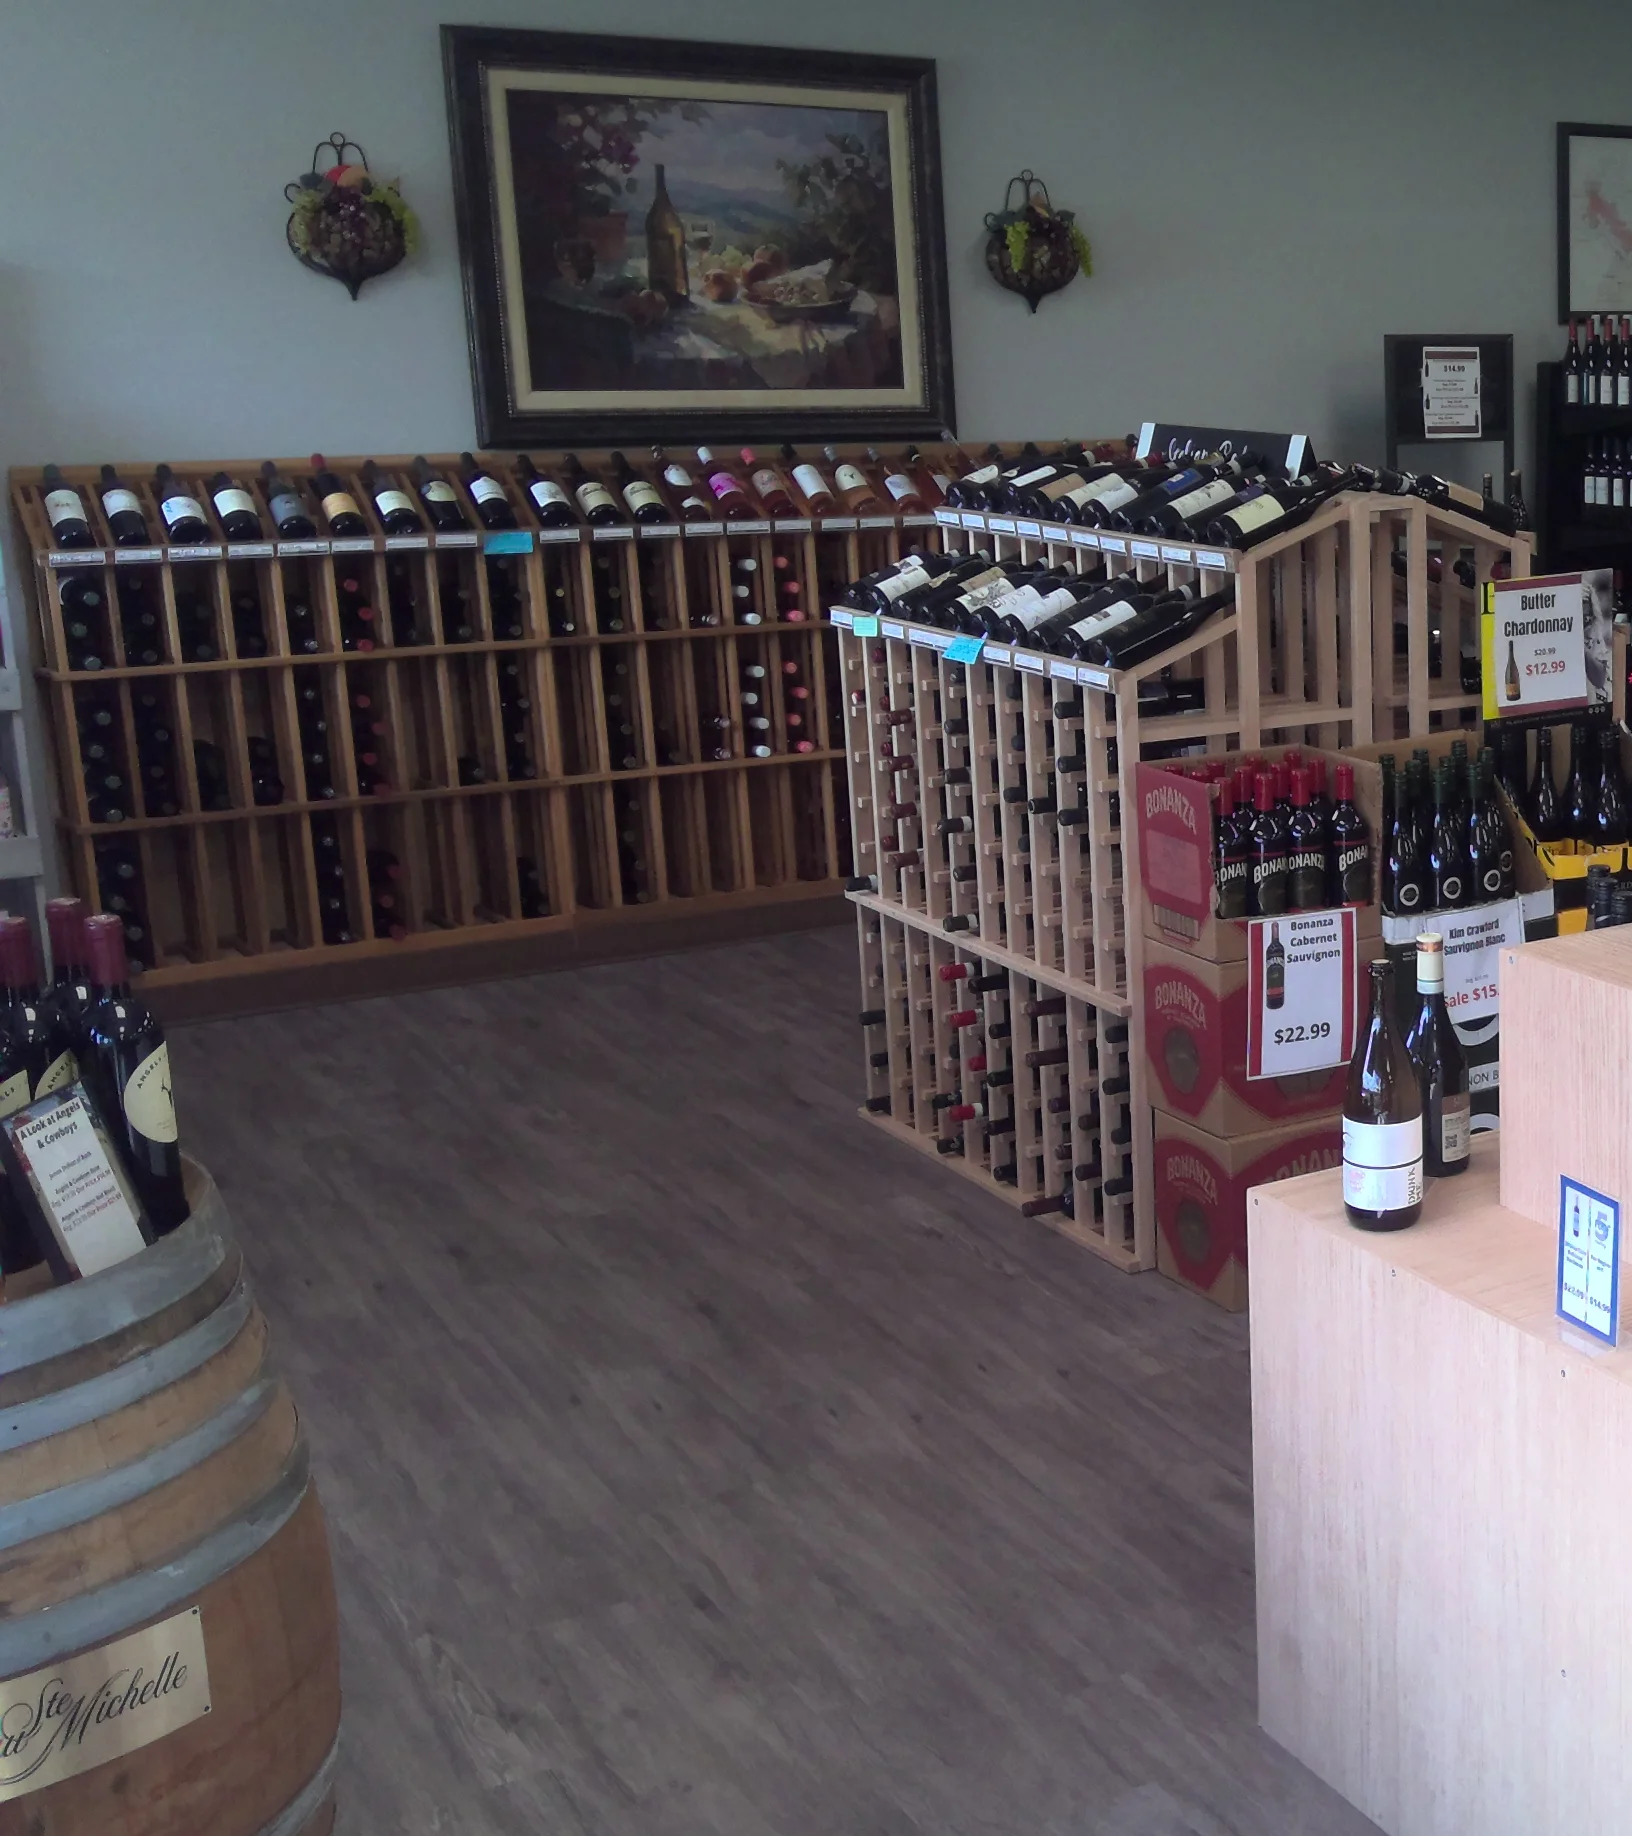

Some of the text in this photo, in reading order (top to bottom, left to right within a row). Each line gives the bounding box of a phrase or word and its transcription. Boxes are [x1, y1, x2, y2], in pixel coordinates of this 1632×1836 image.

[1520, 594, 1556, 611] Butter
[1504, 616, 1573, 637] Chardonnay
[1525, 660, 1566, 676] $12.99
[1145, 786, 1197, 836] BONANZA
[1289, 853, 1325, 872] ONANZ
[1339, 845, 1368, 872] BONA
[1215, 862, 1247, 887] BONAN
[1291, 917, 1334, 931] Bonanza
[1449, 918, 1500, 940] Kim Crawford
[1290, 933, 1337, 947] Cabernet
[1444, 934, 1506, 956] Sauvignon Blanc
[1287, 949, 1341, 964] Sauvignon
[1473, 983, 1500, 1002] $15.
[1155, 980, 1207, 1030] BONANZA
[1274, 1022, 1331, 1045] $22.99
[20, 1102, 81, 1140] A Look at Angels
[36, 1121, 78, 1149] & Cowboys
[20, 1677, 71, 1737] Ste
[58, 1652, 188, 1752] Michelle
